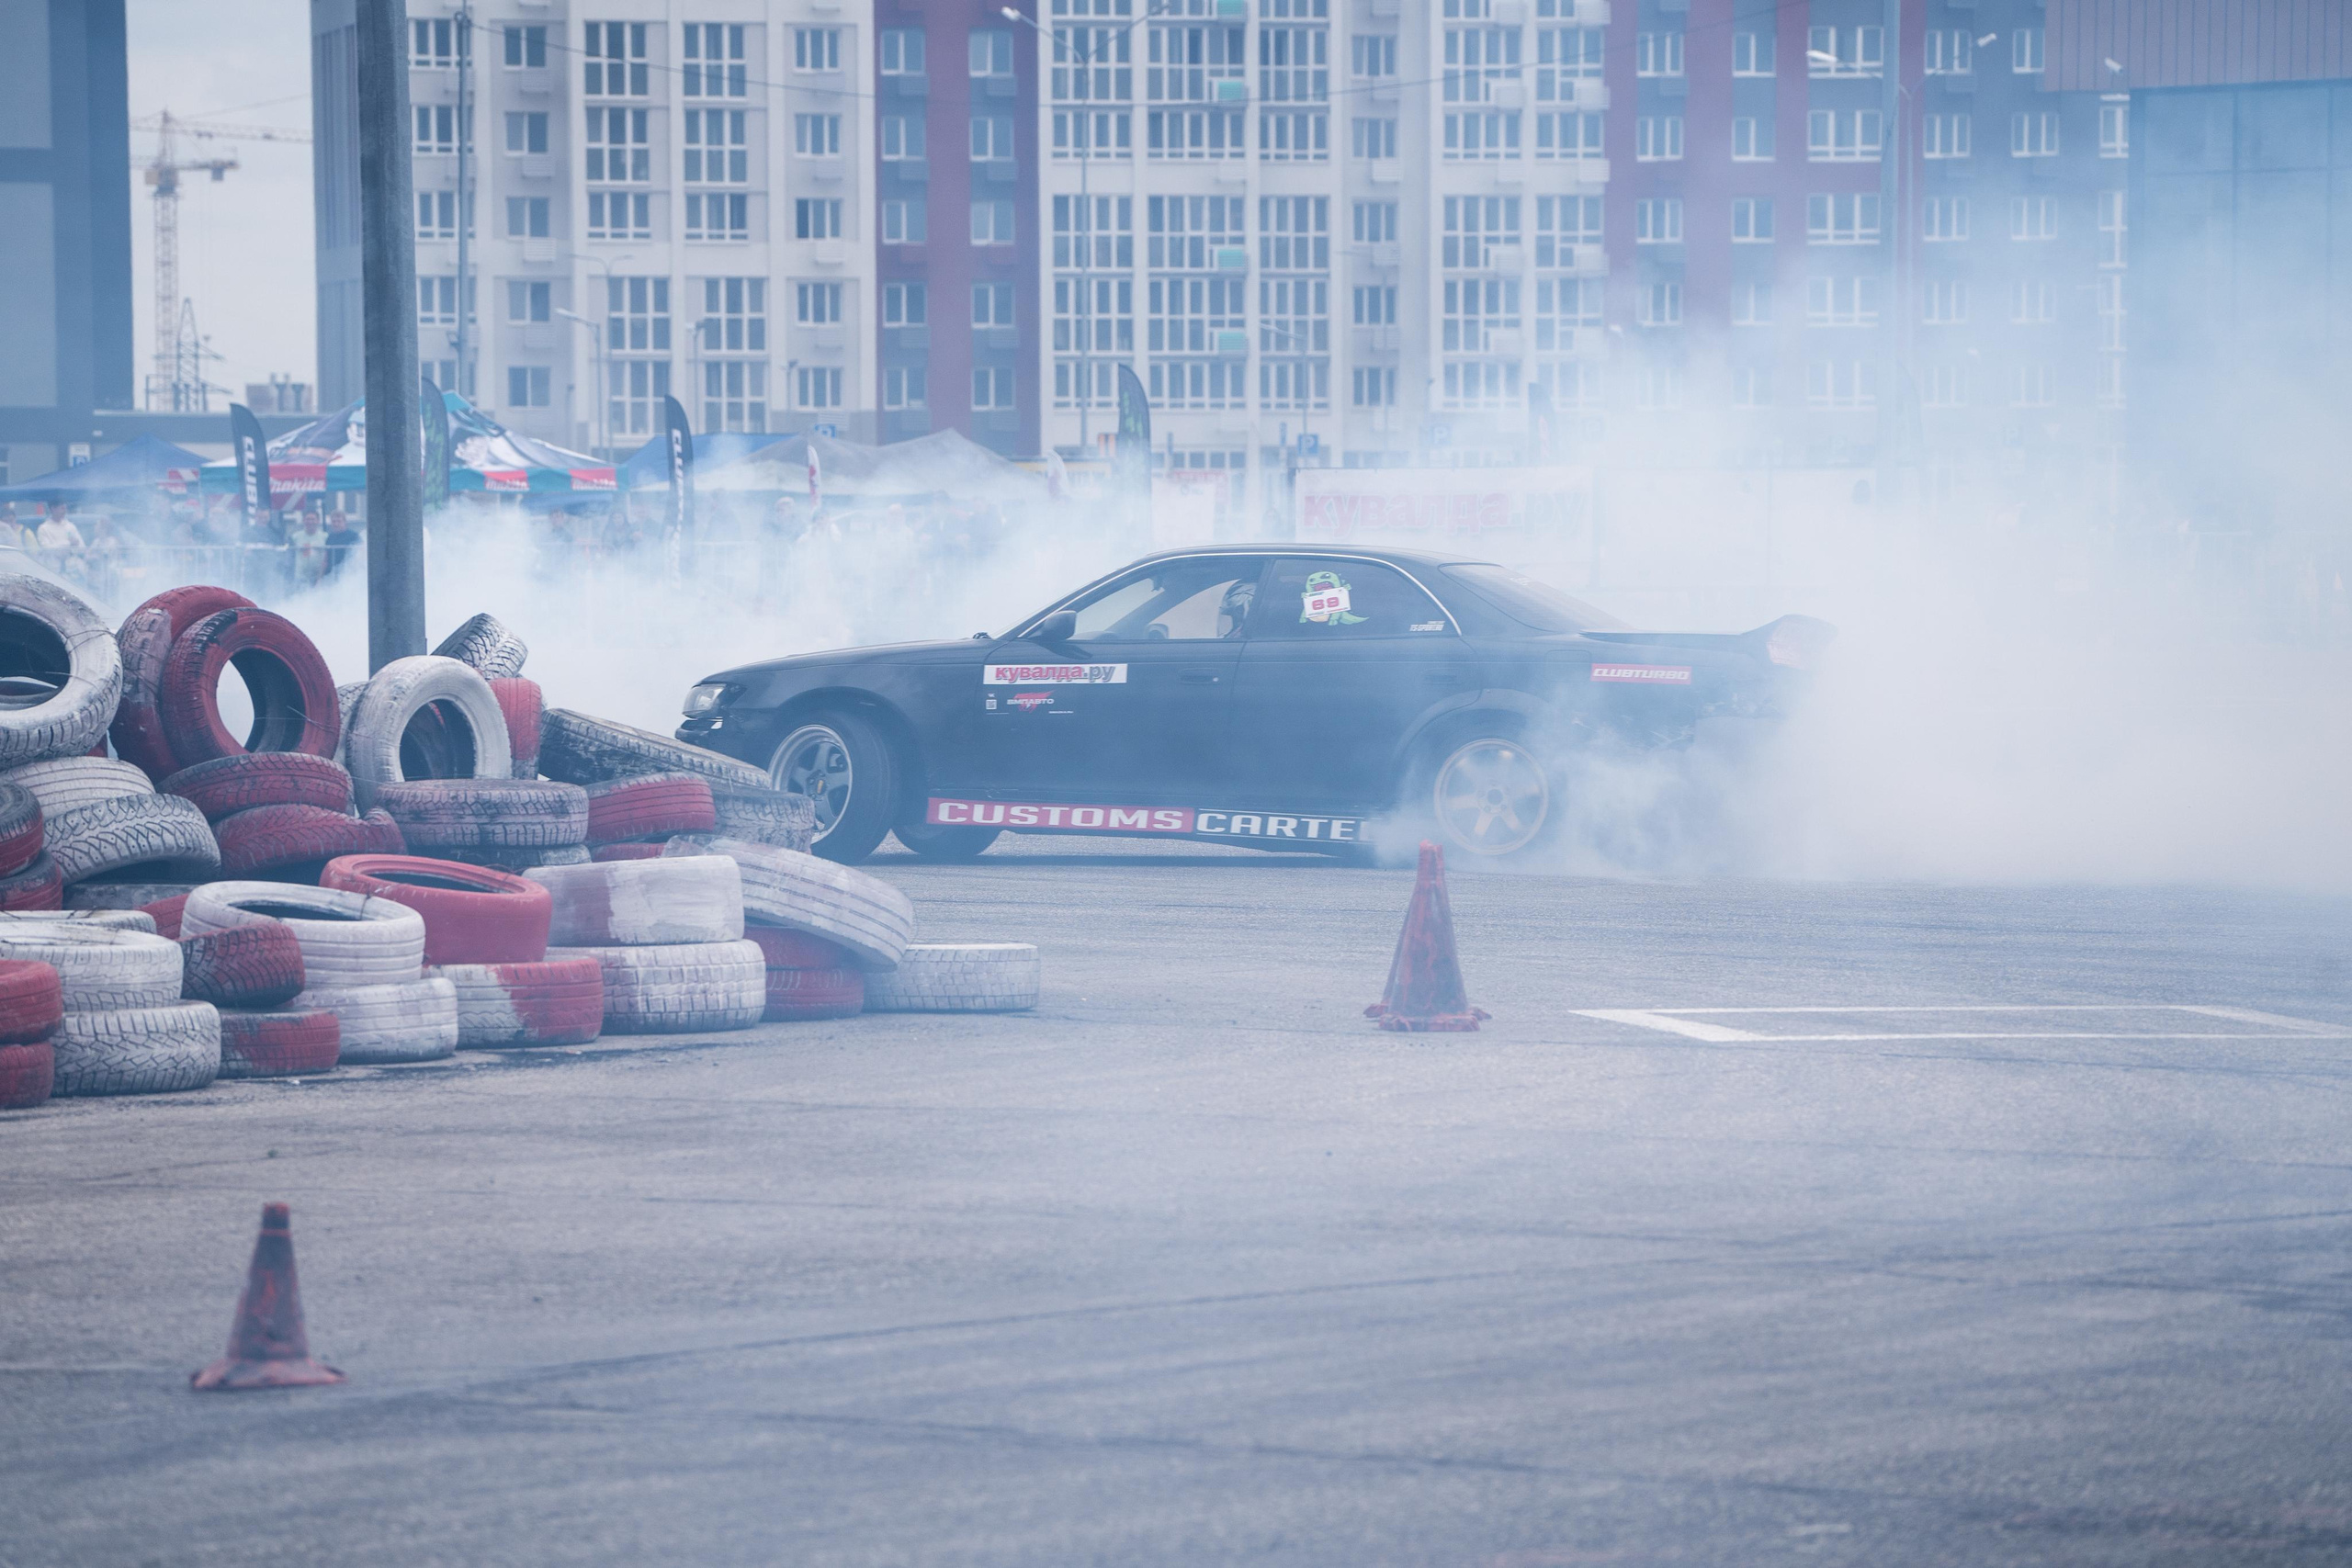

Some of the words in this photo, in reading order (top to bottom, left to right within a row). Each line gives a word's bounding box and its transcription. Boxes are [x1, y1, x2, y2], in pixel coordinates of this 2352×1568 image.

[1304, 434, 1315, 451] P
[1434, 426, 1448, 444] P
[1303, 491, 1588, 539] кувалда.ру
[995, 665, 1116, 683] кувалда.ру
[1593, 668, 1690, 680] CLUBTURBO
[937, 801, 1184, 830] CUSTOMS
